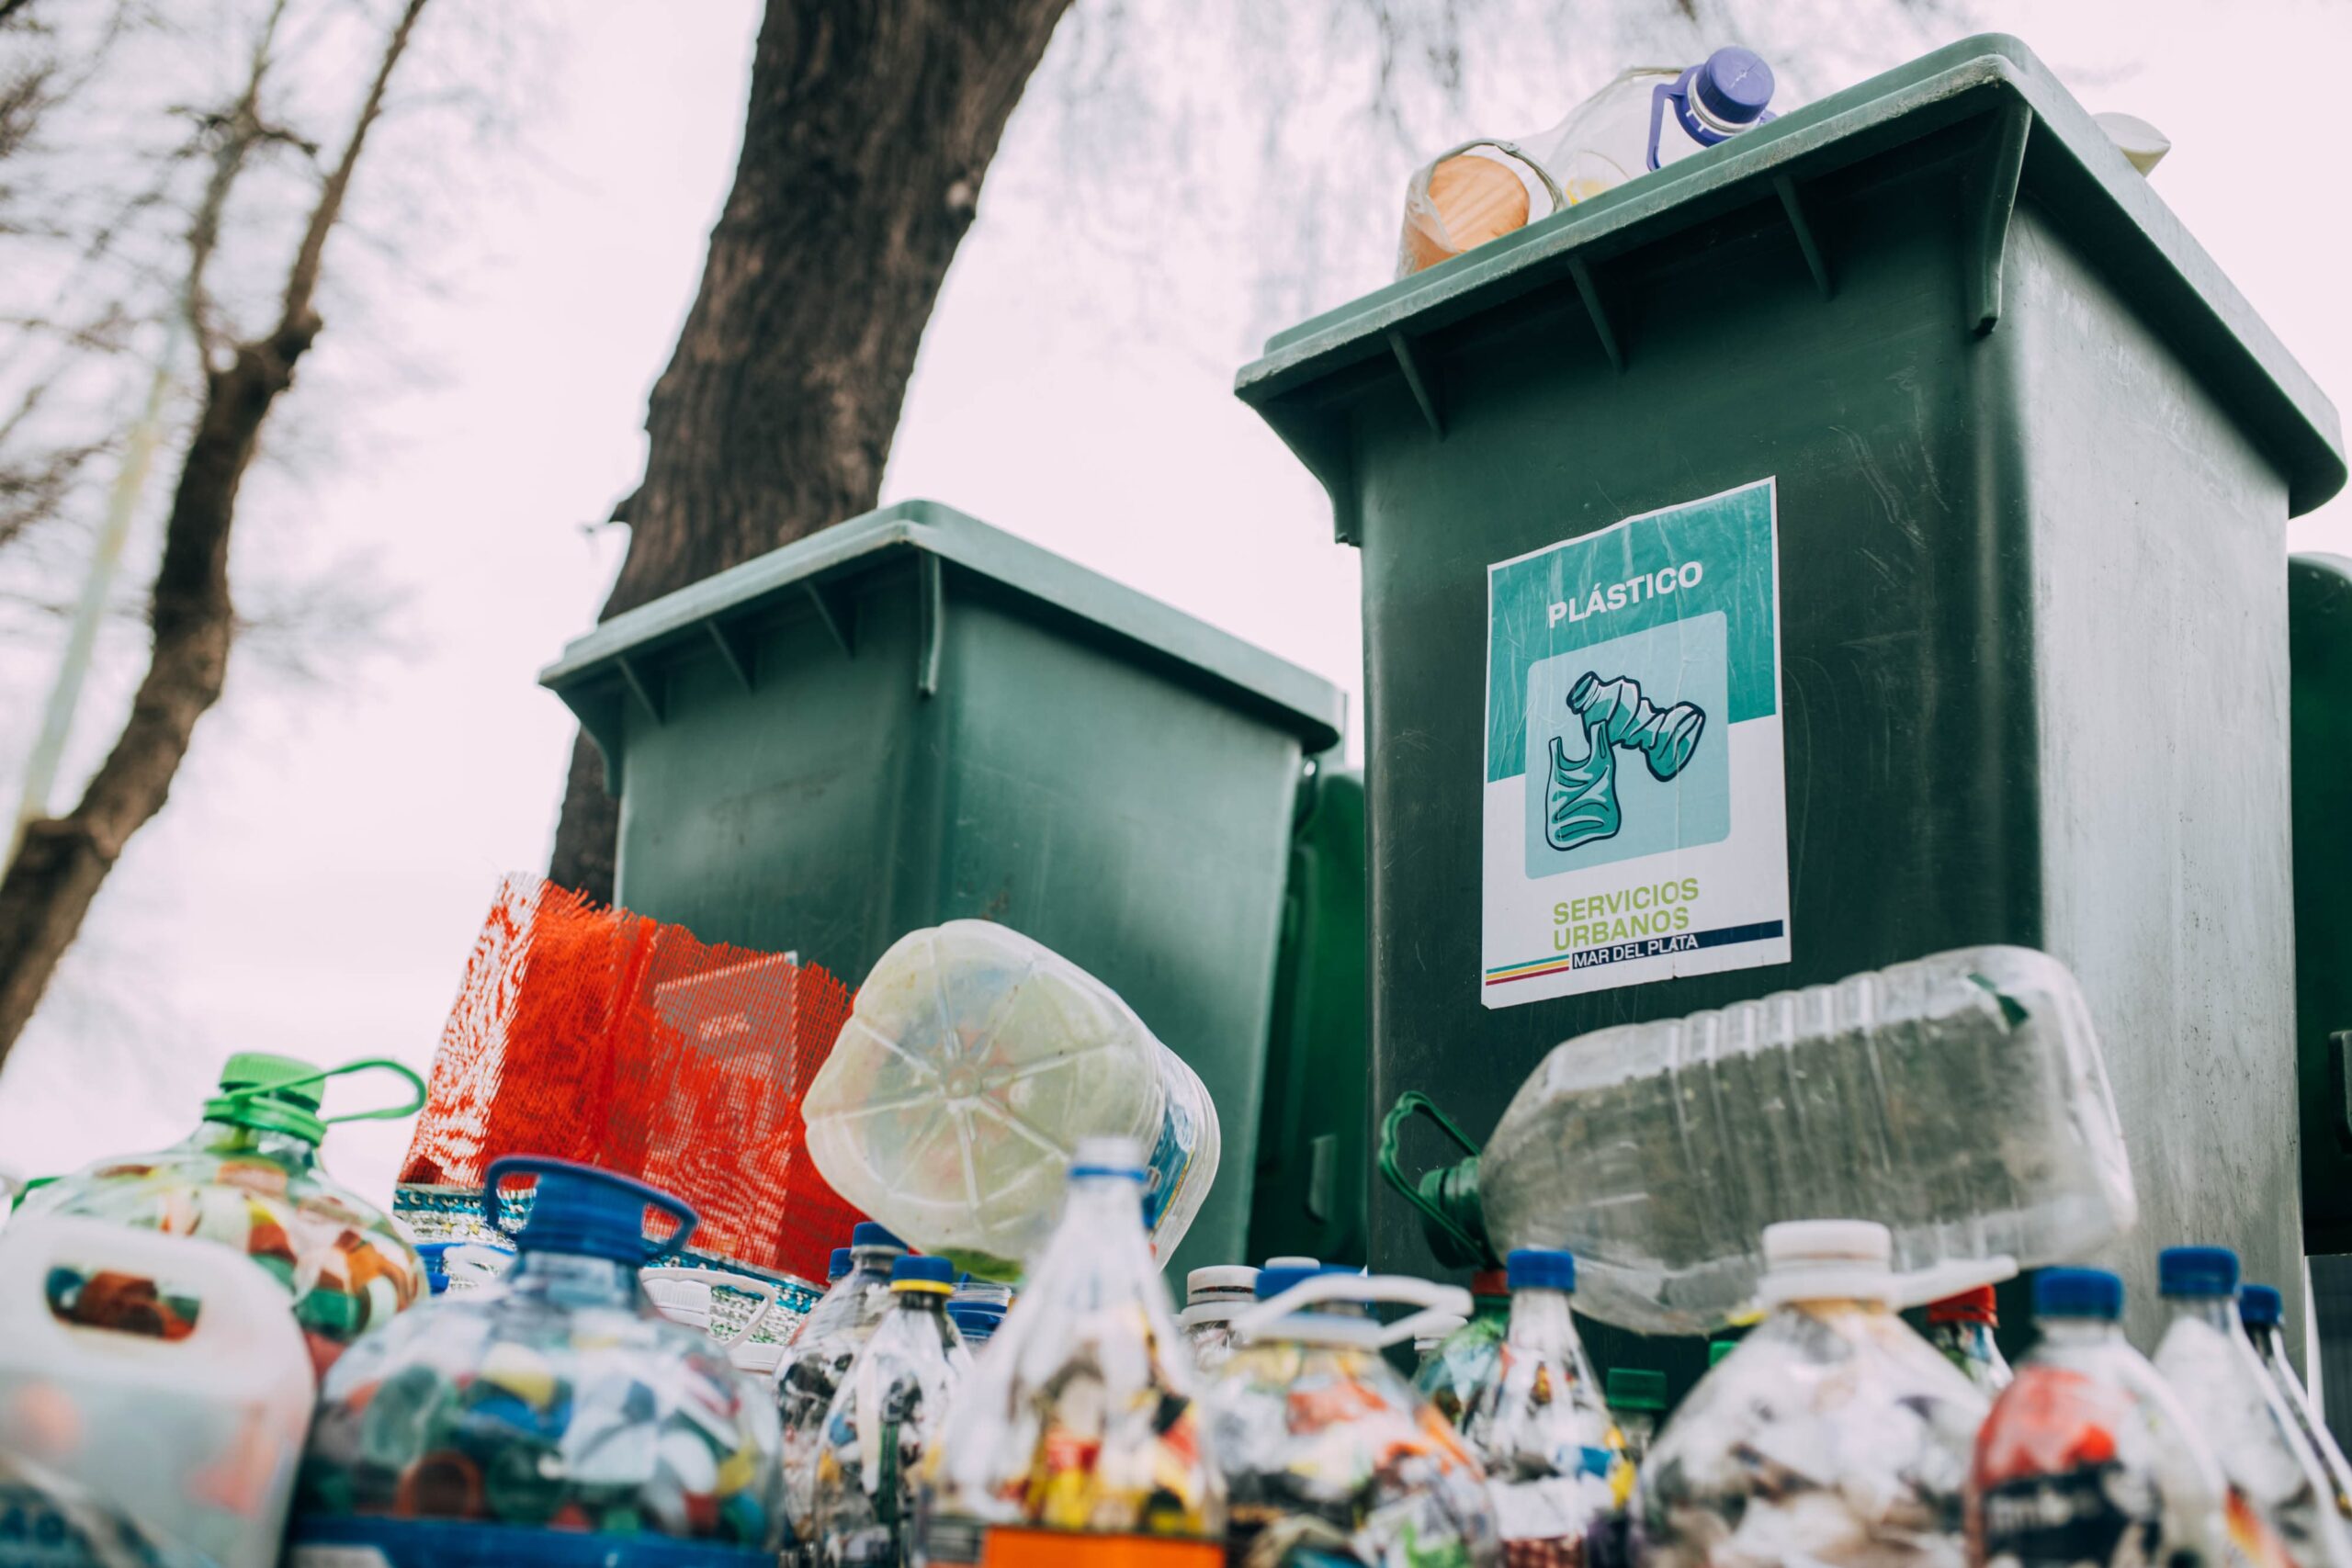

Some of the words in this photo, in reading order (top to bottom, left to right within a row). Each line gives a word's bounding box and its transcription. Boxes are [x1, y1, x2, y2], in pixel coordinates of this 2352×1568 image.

[1548, 561, 1703, 629] PLÁSTICO
[1553, 878, 1699, 925] SERVICIOS
[1554, 907, 1689, 951] URBANOS
[1574, 949, 1610, 968] MAR
[1613, 943, 1645, 962] DEL
[1647, 934, 1699, 955] PLATA
